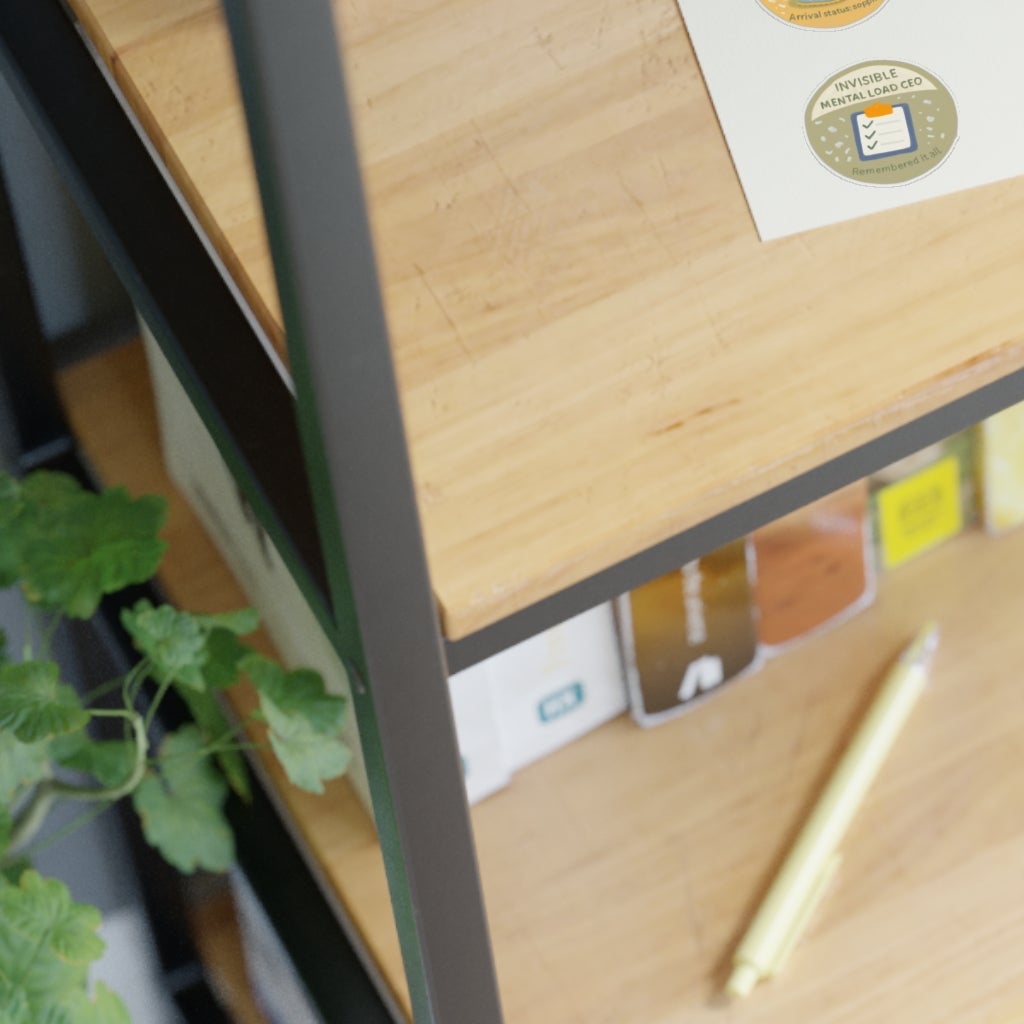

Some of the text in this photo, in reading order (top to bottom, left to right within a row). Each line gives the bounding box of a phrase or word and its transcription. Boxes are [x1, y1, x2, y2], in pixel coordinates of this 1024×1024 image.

[789, 10, 821, 22] Arrival
[823, 6, 852, 18] status:
[834, 68, 898, 92] INVISIBLE
[820, 76, 923, 110] MENTAL LOAD CEO
[852, 158, 923, 176] Remembered
[920, 154, 929, 162] it
